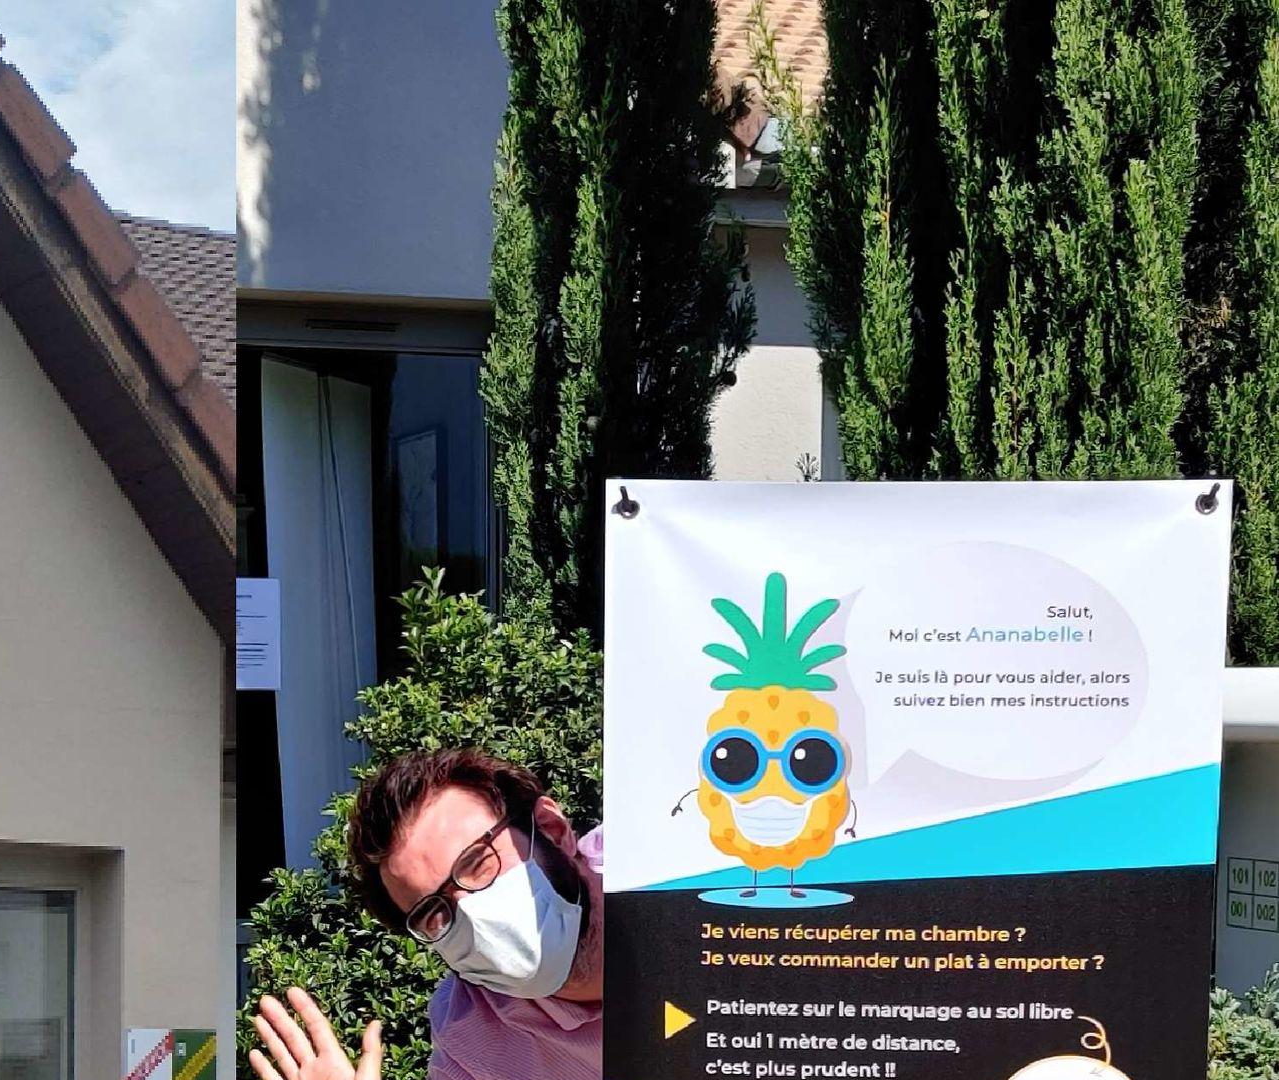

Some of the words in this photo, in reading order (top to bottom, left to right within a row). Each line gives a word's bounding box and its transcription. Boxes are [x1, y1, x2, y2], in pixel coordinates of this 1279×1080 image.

[1047, 606, 1092, 619] Salut,
[890, 629, 917, 642] Moi
[924, 629, 961, 642] c'est
[966, 626, 1084, 642] Ananabelle
[1089, 630, 1092, 642] !
[876, 672, 892, 683] Je
[898, 670, 930, 683] suis
[935, 671, 948, 683] là
[954, 674, 992, 685] pour
[996, 674, 1035, 683] vous
[1040, 670, 1085, 685] aider,
[1090, 671, 1130, 683] alors
[894, 694, 945, 706] suivez
[950, 694, 984, 706] bien
[991, 697, 1025, 706] mes
[1031, 694, 1129, 707] instructions
[1233, 868, 1248, 884] 101
[1258, 870, 1276, 887] 102
[1230, 901, 1247, 918] 001
[1257, 904, 1275, 921] 002
[701, 924, 724, 938] Je
[728, 923, 779, 939] viens
[785, 924, 880, 943] récupérer
[885, 929, 916, 940] ma
[921, 925, 1010, 941] chambre
[1015, 927, 1026, 942] ?
[701, 951, 724, 965] Je
[728, 954, 775, 966] veux
[779, 952, 899, 968] commander
[905, 957, 930, 968] un
[935, 953, 972, 971] plat
[978, 953, 989, 969] à
[995, 955, 1089, 972] emporter
[1092, 955, 1104, 969] ?
[707, 999, 799, 1016] Patientez
[803, 1004, 834, 1016] sur
[839, 1001, 856, 1017] le
[862, 1005, 962, 1021] marquage
[967, 1007, 991, 1018] au
[995, 1003, 1024, 1018] sol
[1029, 1003, 1074, 1019] libre
[707, 1032, 727, 1048] Et
[732, 1032, 761, 1048] oui
[766, 1033, 773, 1048] 1
[779, 1033, 838, 1049] mètre
[842, 1034, 867, 1050] de
[872, 1034, 960, 1053] distance,
[706, 1059, 750, 1074] c'est
[756, 1060, 796, 1078] plus
[801, 1061, 880, 1079] prudent
[885, 1062, 896, 1077] !!
